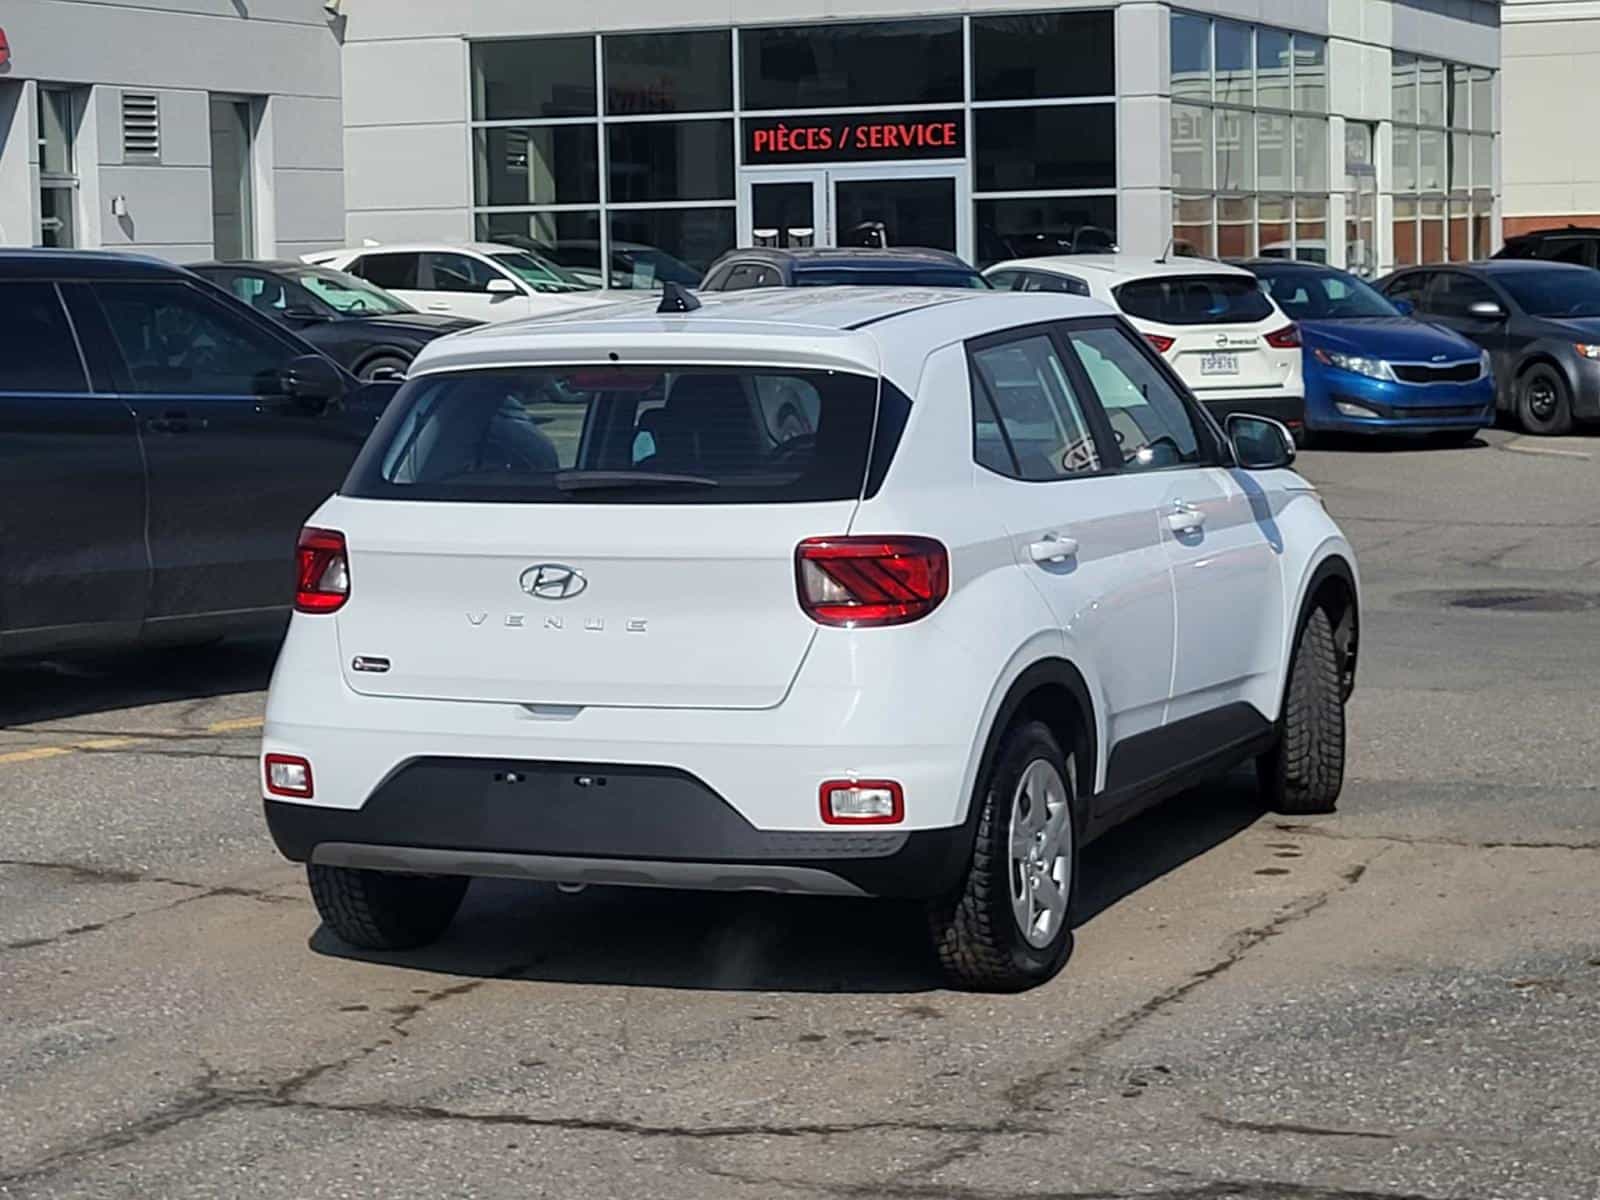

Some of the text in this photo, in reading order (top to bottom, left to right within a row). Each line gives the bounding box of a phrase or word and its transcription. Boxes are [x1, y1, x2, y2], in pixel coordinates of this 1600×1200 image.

[754, 123, 833, 152] PIÈCES
[855, 122, 957, 148] SERVICE
[465, 611, 649, 633] VENUE
